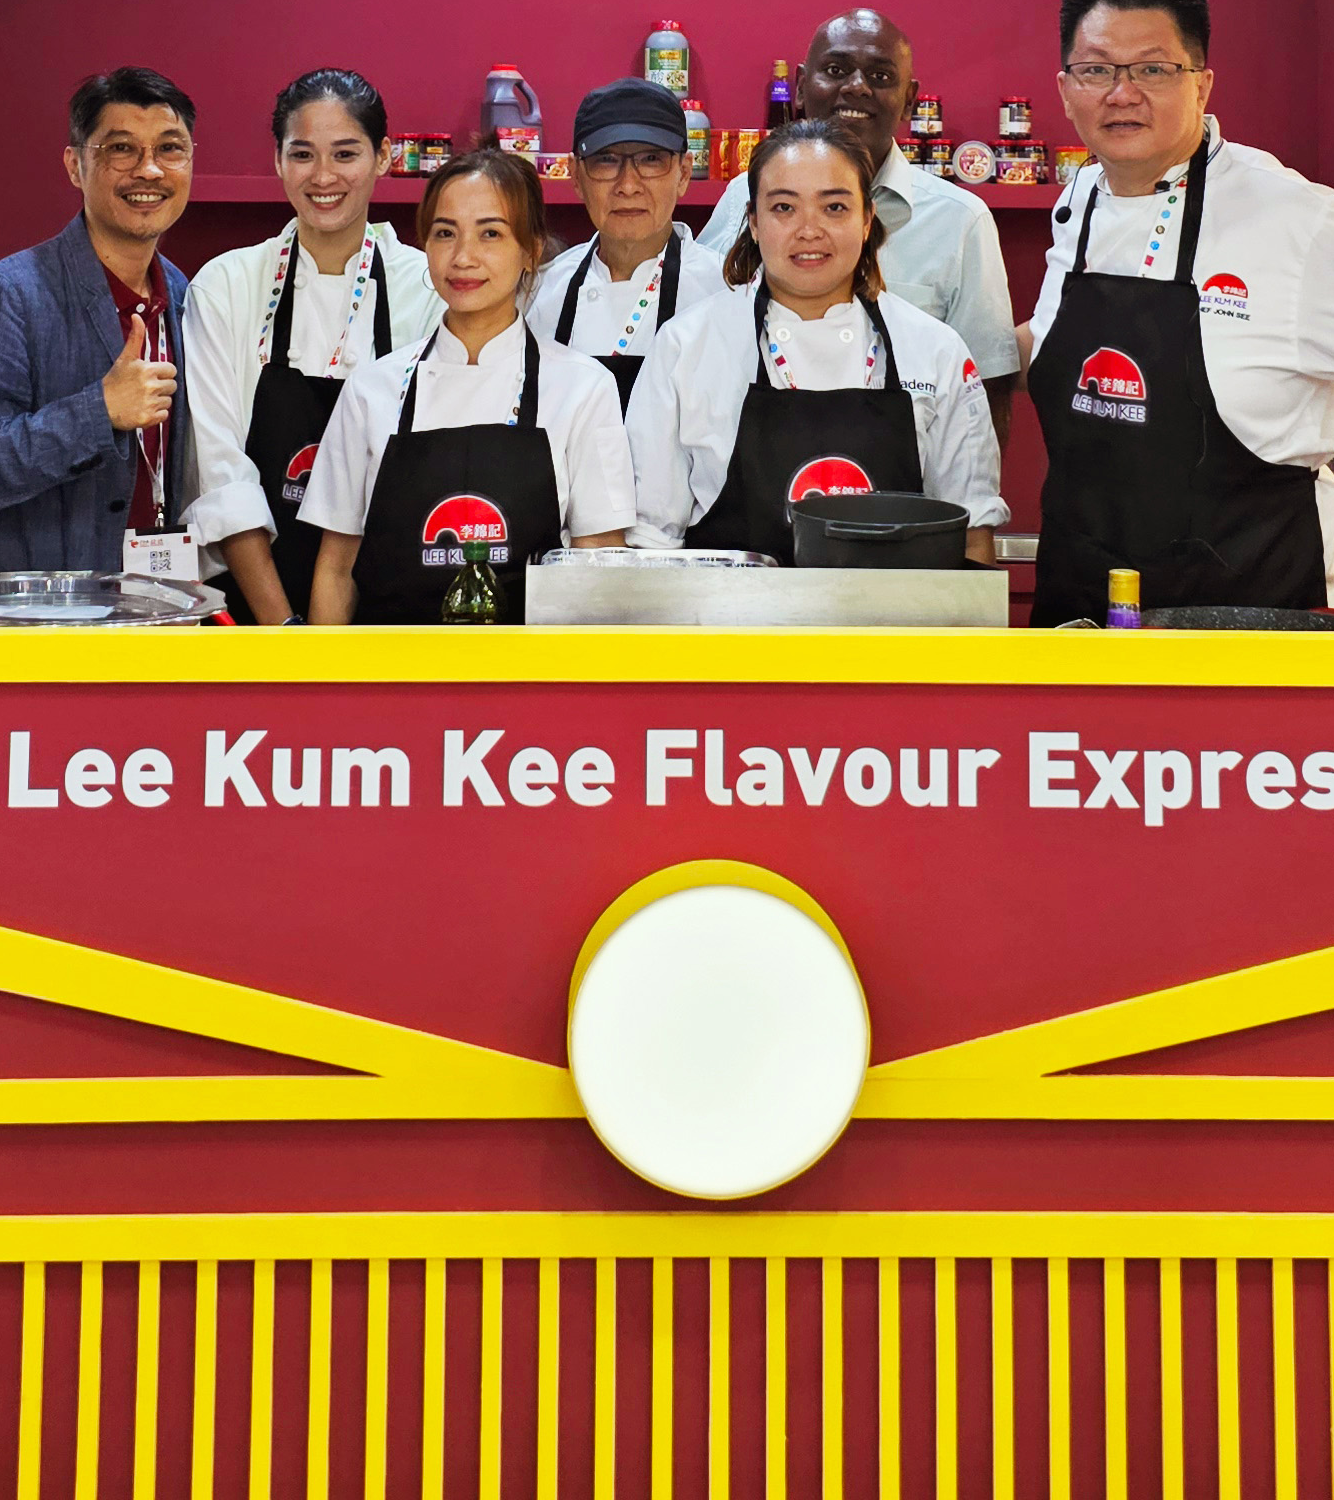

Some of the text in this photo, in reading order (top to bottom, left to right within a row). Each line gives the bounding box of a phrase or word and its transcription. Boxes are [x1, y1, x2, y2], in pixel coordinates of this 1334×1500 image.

[1233, 299, 1247, 309] KEE
[900, 379, 936, 395] adem
[1100, 377, 1140, 396] 李錦記
[1072, 393, 1093, 413] LEE
[1118, 404, 1147, 423] KEE
[282, 483, 306, 502] LEE
[460, 523, 501, 538] 李錦記
[423, 546, 509, 565] LEE KU EE
[7, 730, 174, 809] Lee
[204, 730, 411, 809] Kum
[443, 729, 616, 808] Kee
[645, 729, 1002, 809] Flavour
